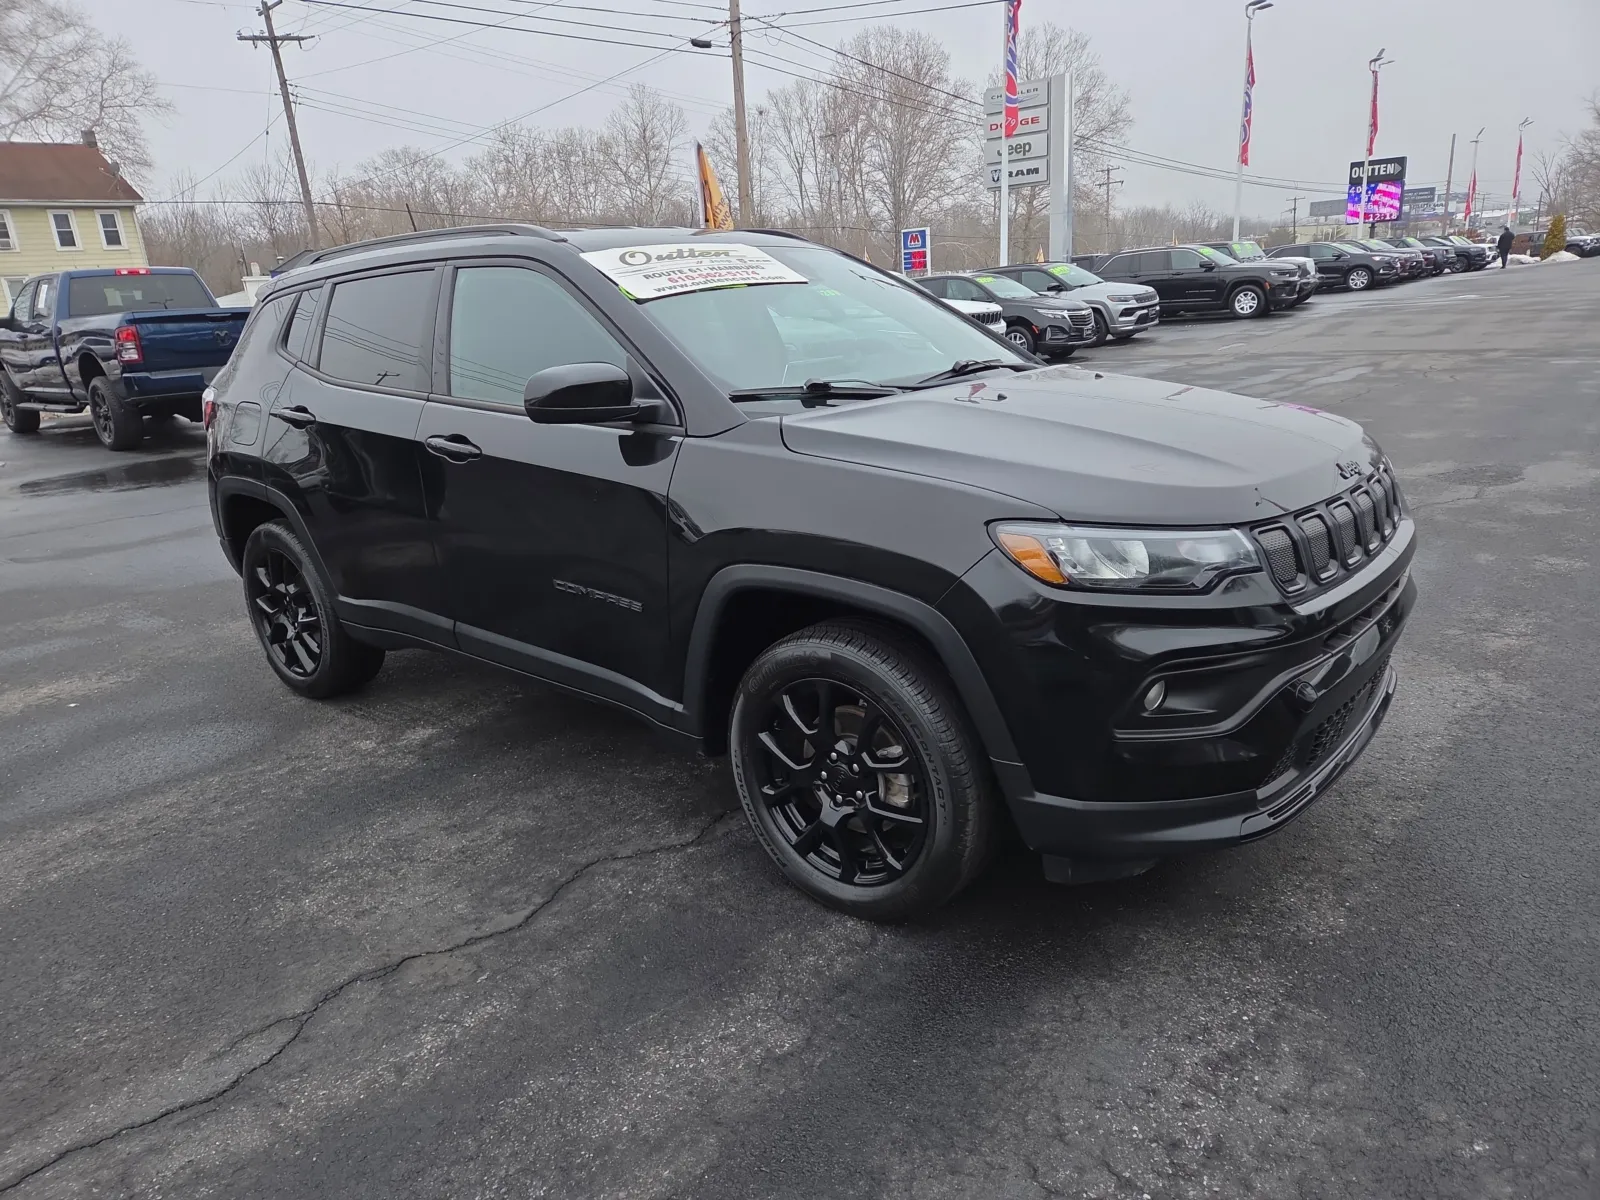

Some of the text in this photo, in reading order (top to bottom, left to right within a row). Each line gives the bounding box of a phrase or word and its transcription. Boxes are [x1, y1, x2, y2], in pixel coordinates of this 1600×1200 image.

[990, 87, 1039, 100] CHLER
[989, 116, 1040, 131] DGE
[618, 248, 731, 266] Outten
[642, 268, 686, 280] ROUTE
[653, 275, 787, 293] www.outtencars.com
